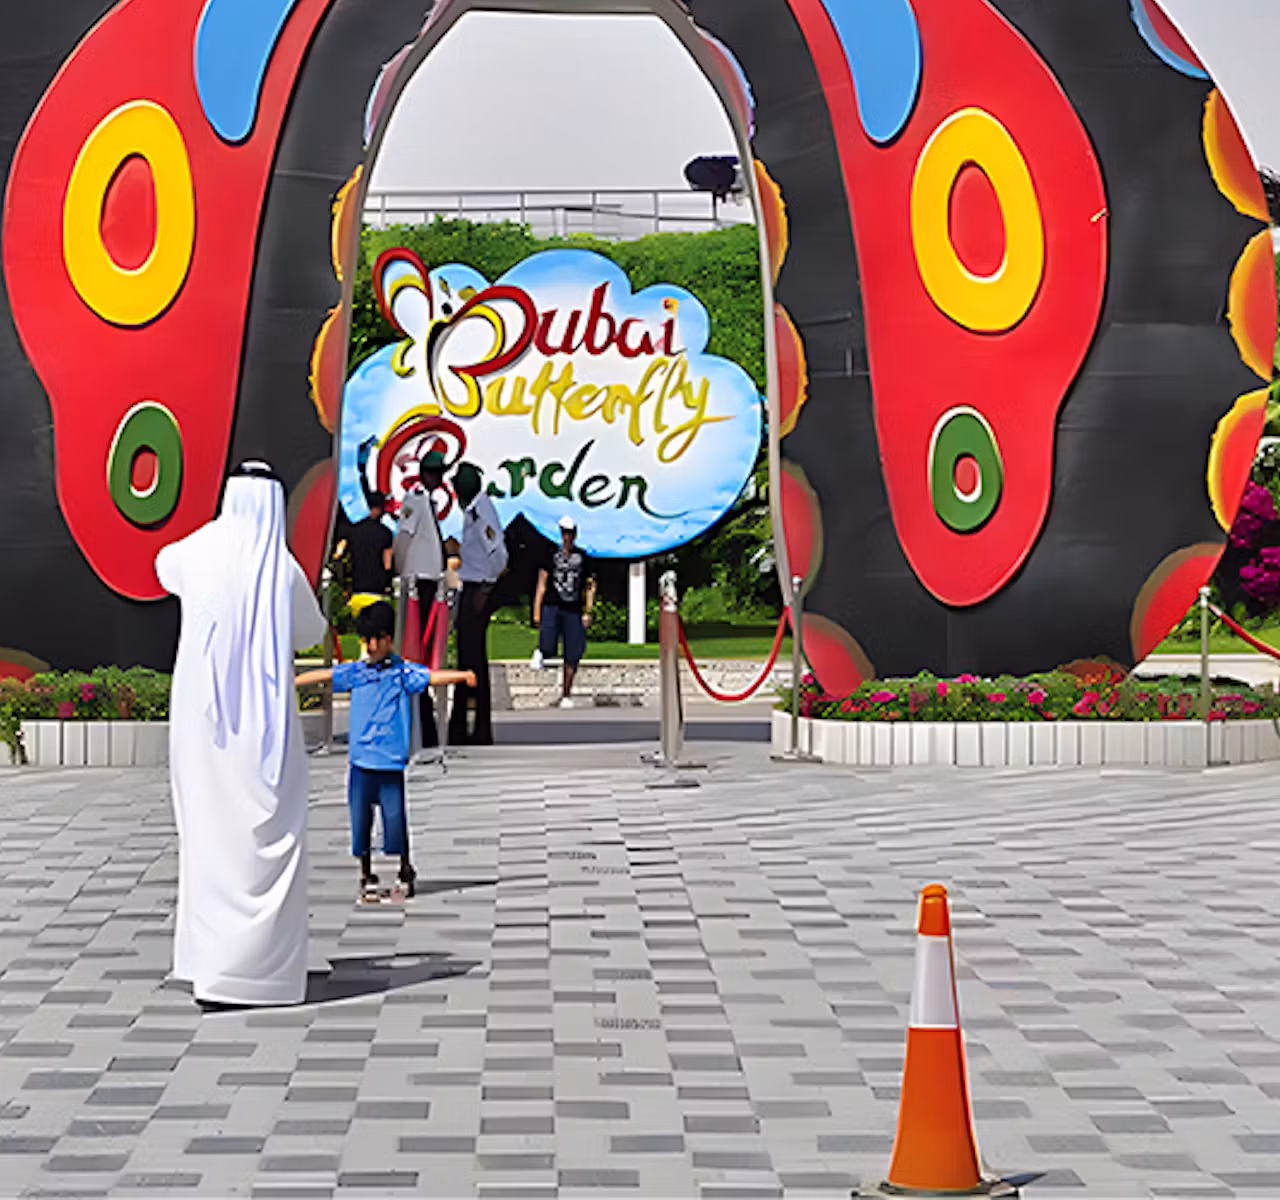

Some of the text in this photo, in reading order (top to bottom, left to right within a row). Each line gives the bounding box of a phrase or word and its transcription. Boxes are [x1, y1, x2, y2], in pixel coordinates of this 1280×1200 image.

[426, 281, 687, 378] Dubai
[427, 352, 735, 463] Butterfly
[375, 412, 690, 521] Grden
